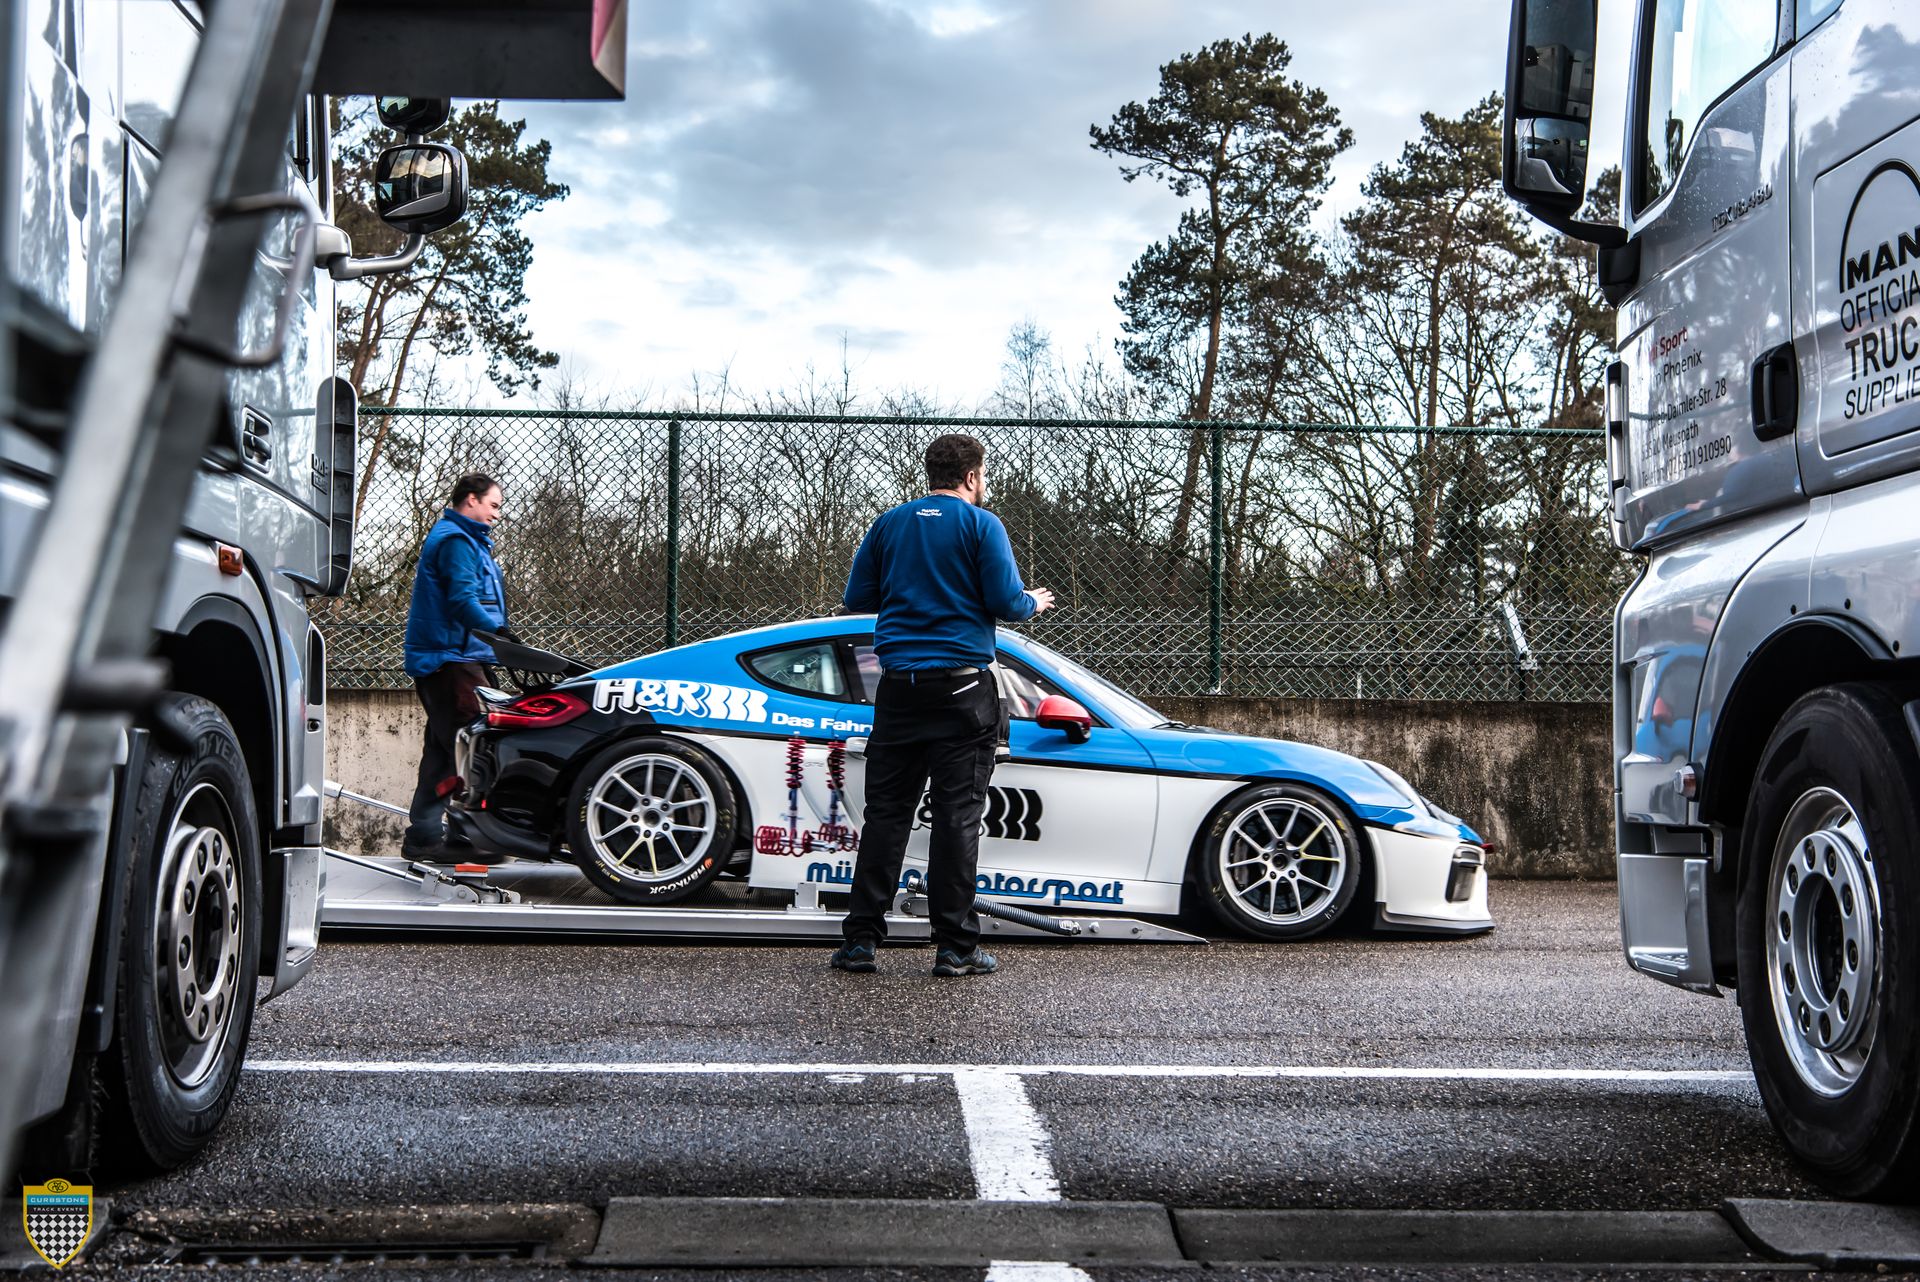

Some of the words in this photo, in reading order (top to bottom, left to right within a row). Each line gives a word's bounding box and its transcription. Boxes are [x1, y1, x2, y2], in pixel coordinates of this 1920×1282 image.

[1847, 225, 1920, 290] MAN
[1660, 326, 1688, 357] Sport
[1663, 348, 1703, 382] Phoenix
[1715, 378, 1727, 399] 28
[1698, 435, 1732, 464] 910990
[593, 678, 709, 718] H&R
[772, 712, 815, 729] Das
[820, 717, 873, 733] Fahr
[976, 871, 1123, 906] otorsport
